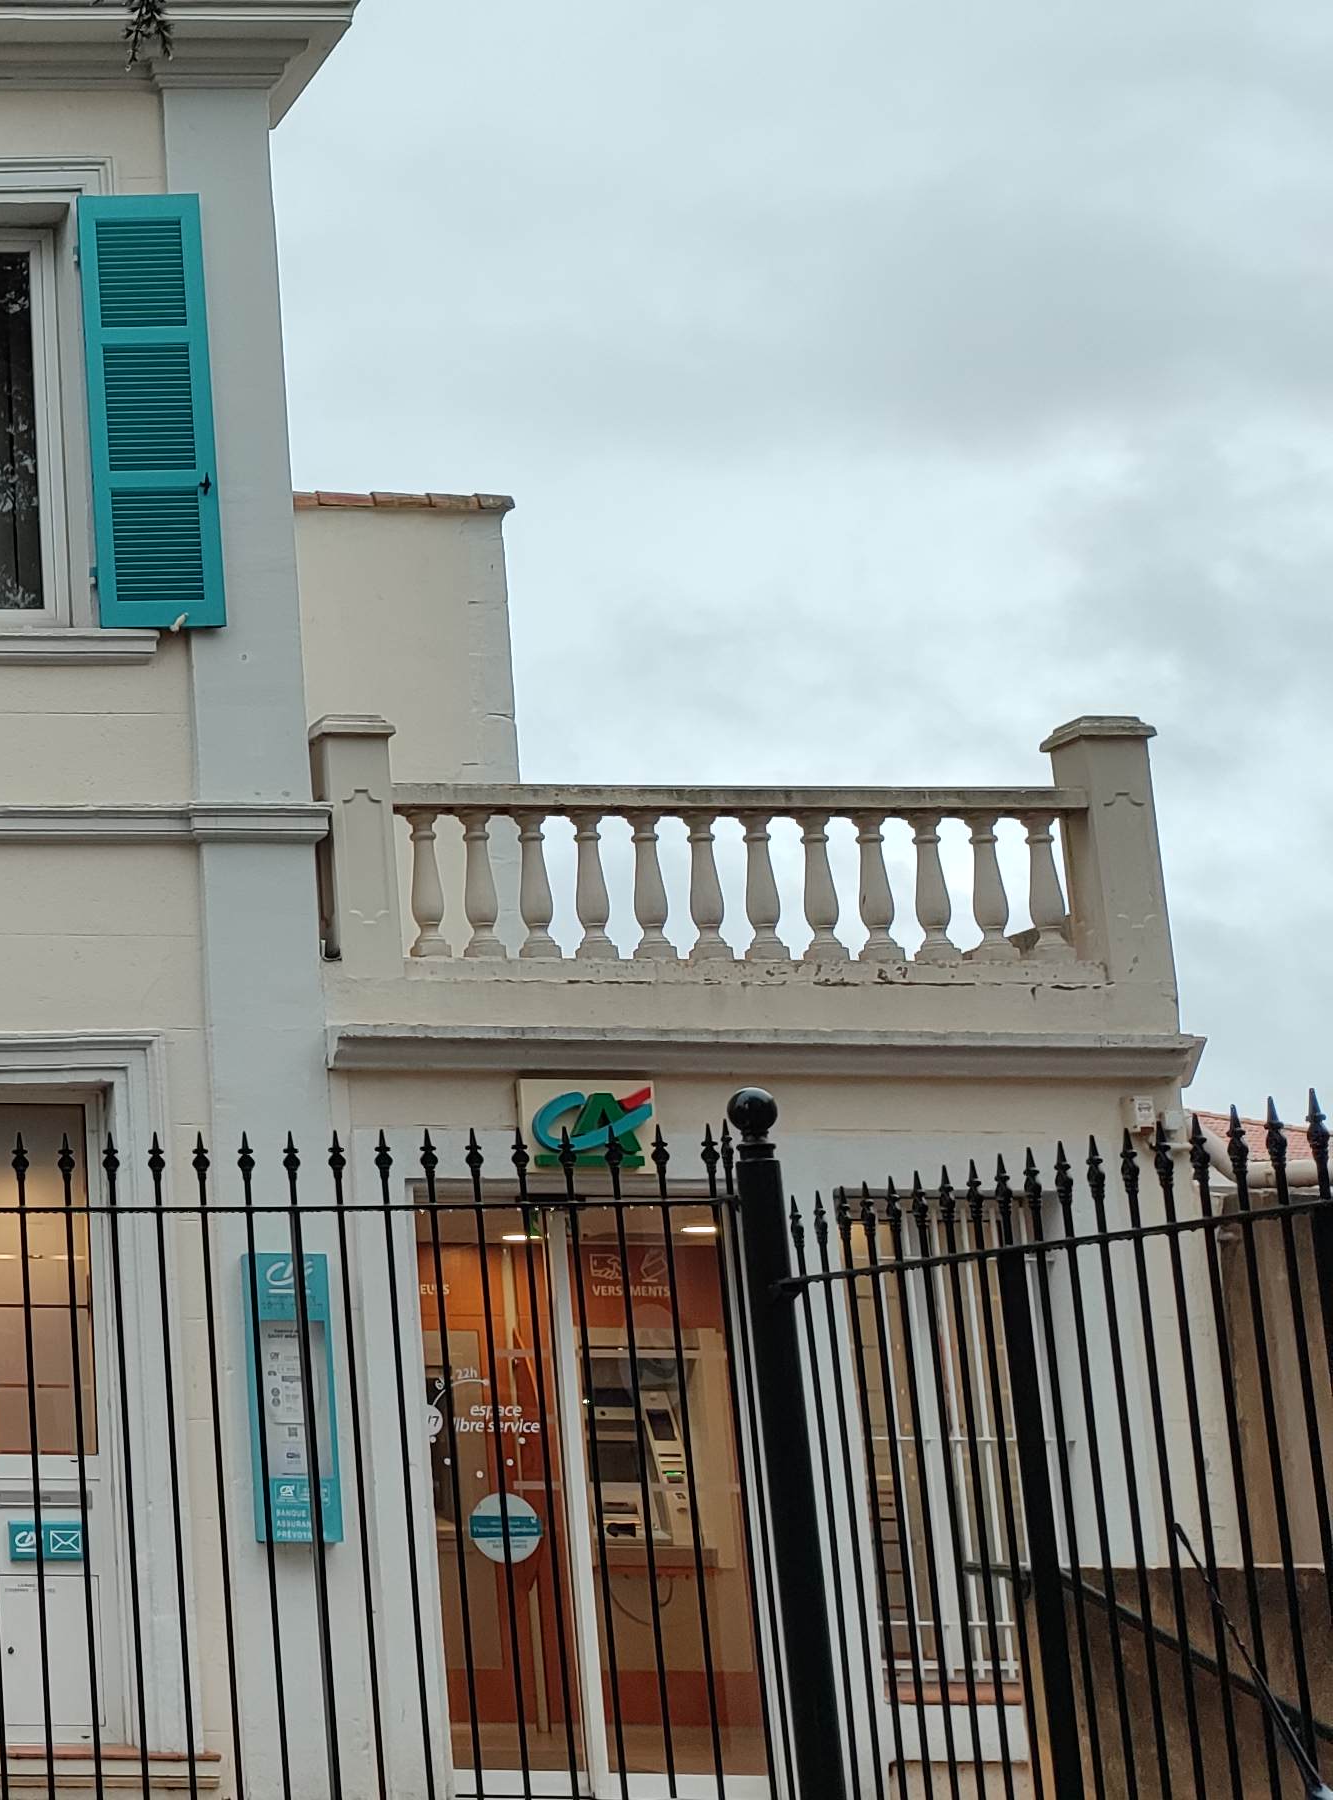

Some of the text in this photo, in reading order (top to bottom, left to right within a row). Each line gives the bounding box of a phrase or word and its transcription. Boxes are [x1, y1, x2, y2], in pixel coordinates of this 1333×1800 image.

[592, 1285, 671, 1297] VERSMENTS
[456, 1366, 477, 1379] 22h
[487, 1418, 541, 1433] srvice
[276, 1509, 307, 1518] BANQUE
